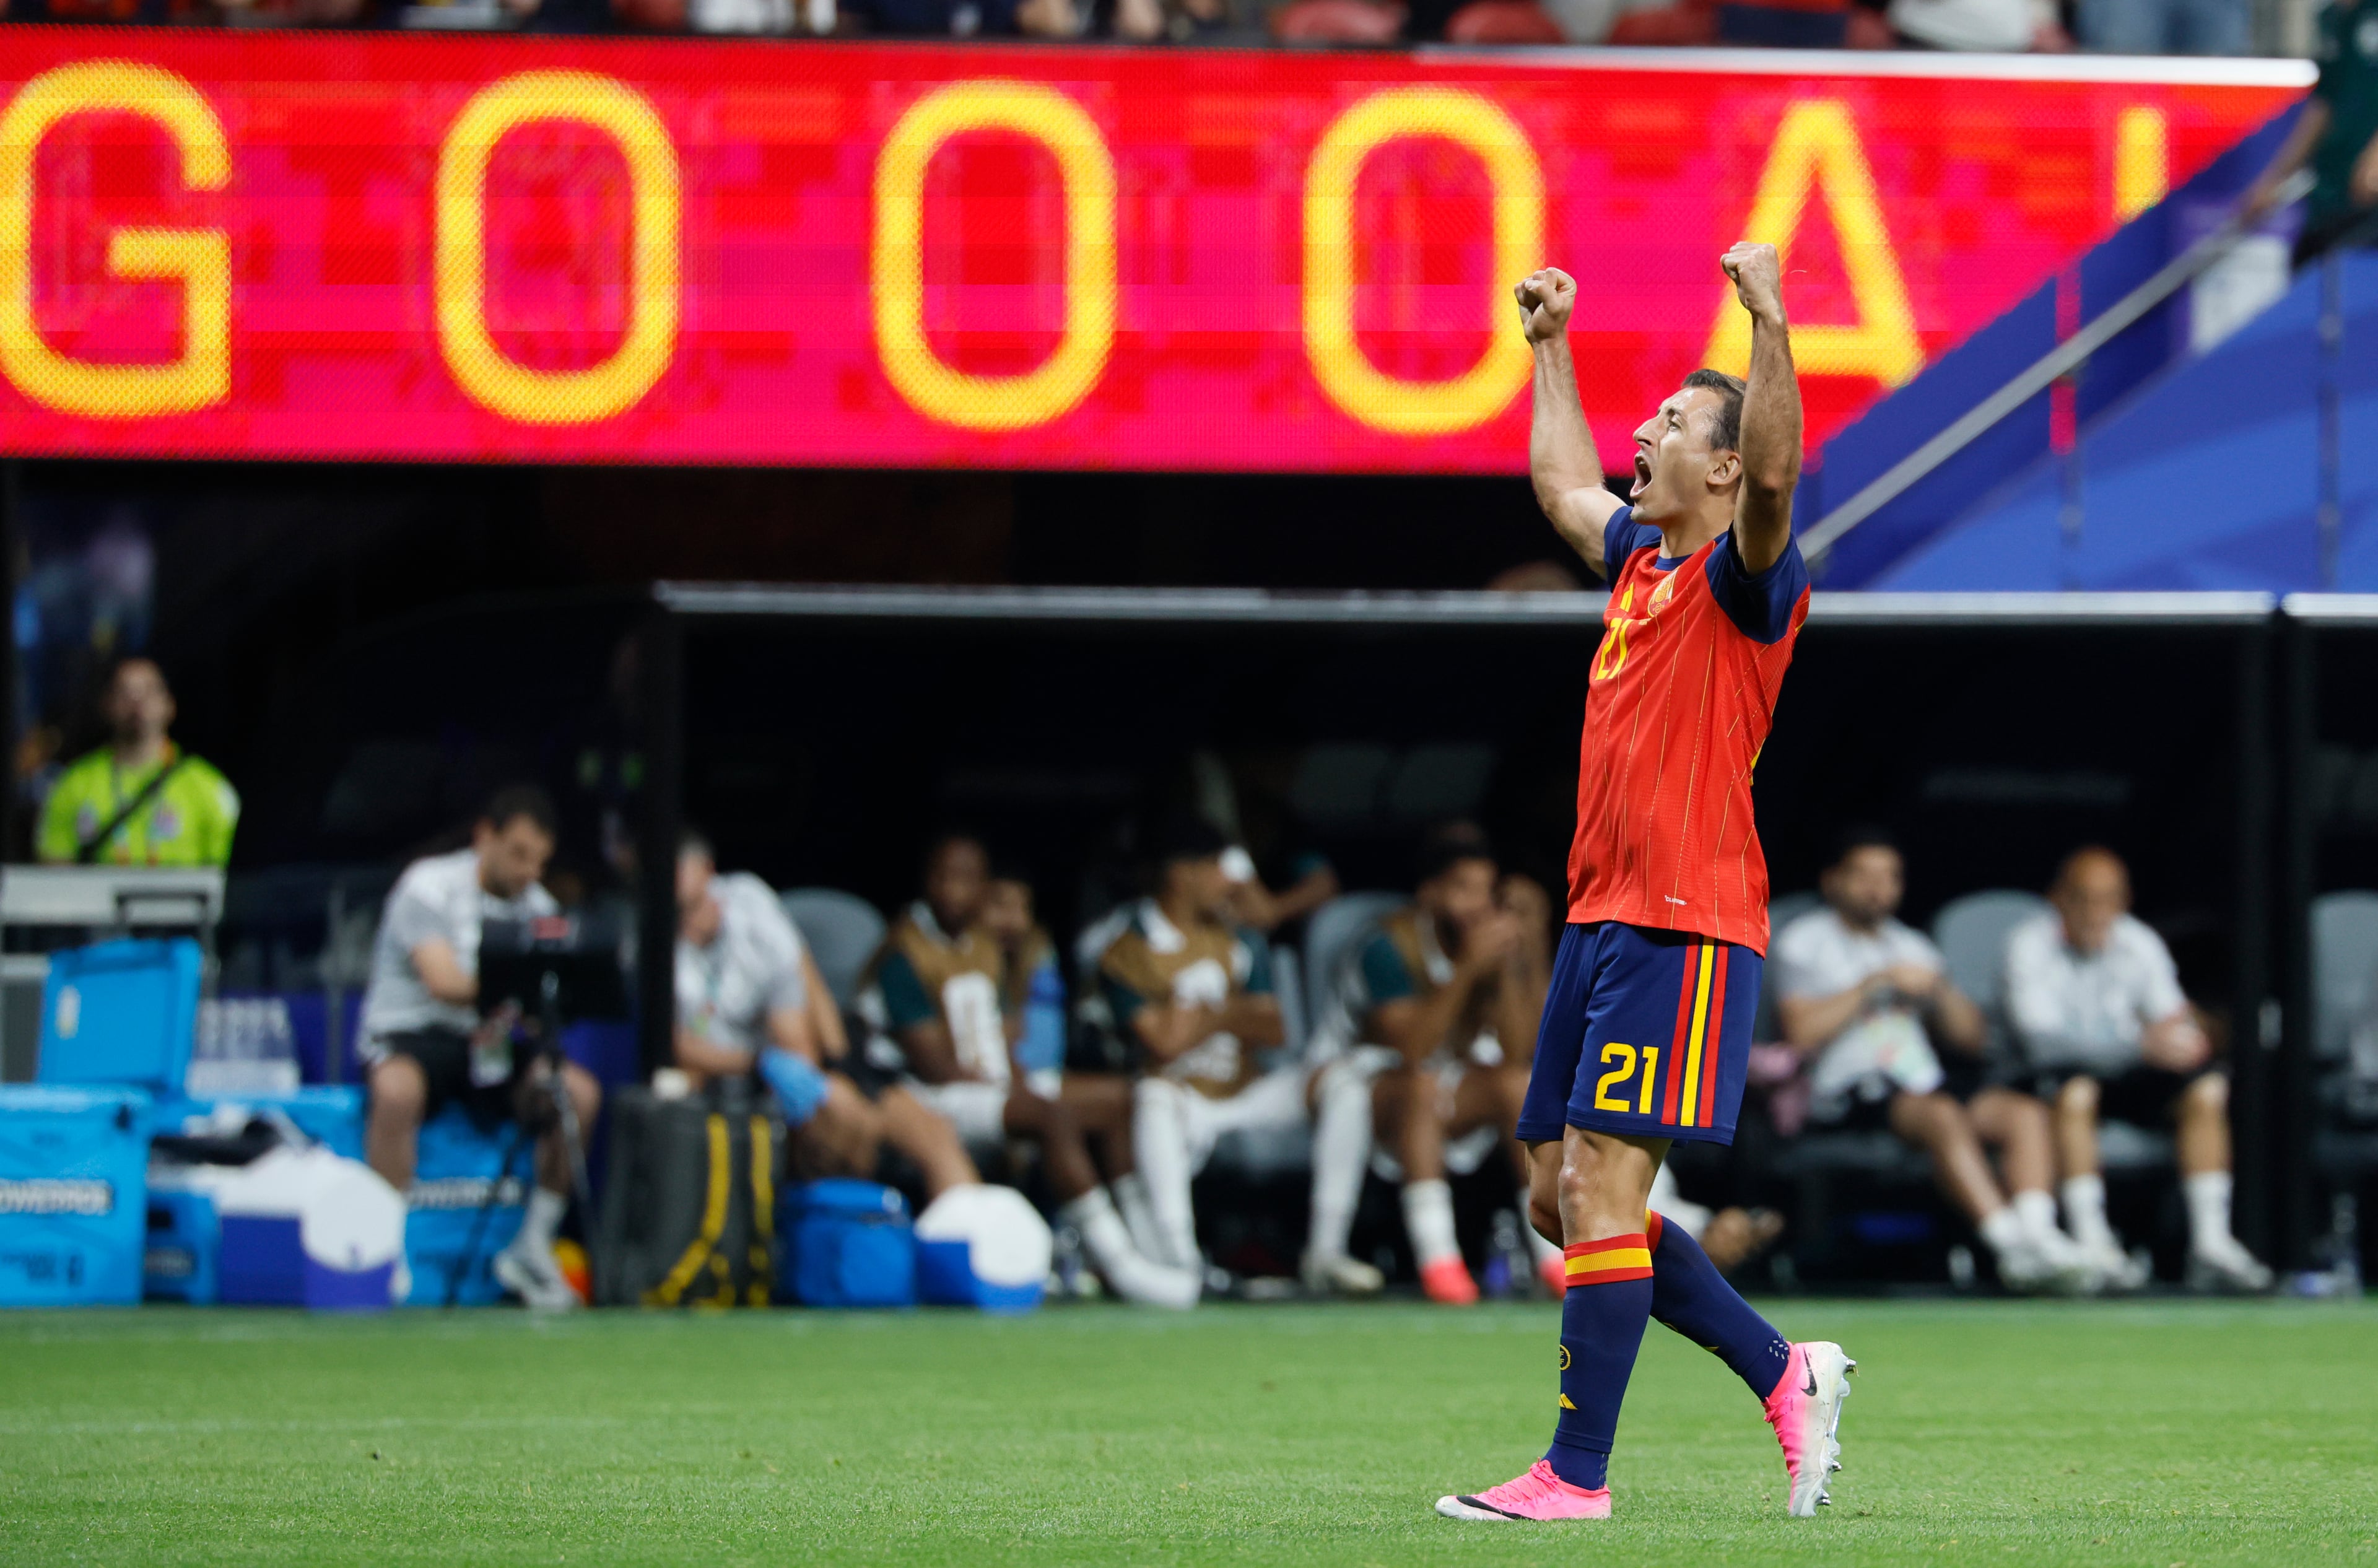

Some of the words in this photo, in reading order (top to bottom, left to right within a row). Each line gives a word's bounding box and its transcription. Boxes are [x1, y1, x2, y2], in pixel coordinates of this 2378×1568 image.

[0, 61, 2169, 435] GOOOA
[1595, 617, 1634, 681] 21
[1594, 1042, 1659, 1115] 21
